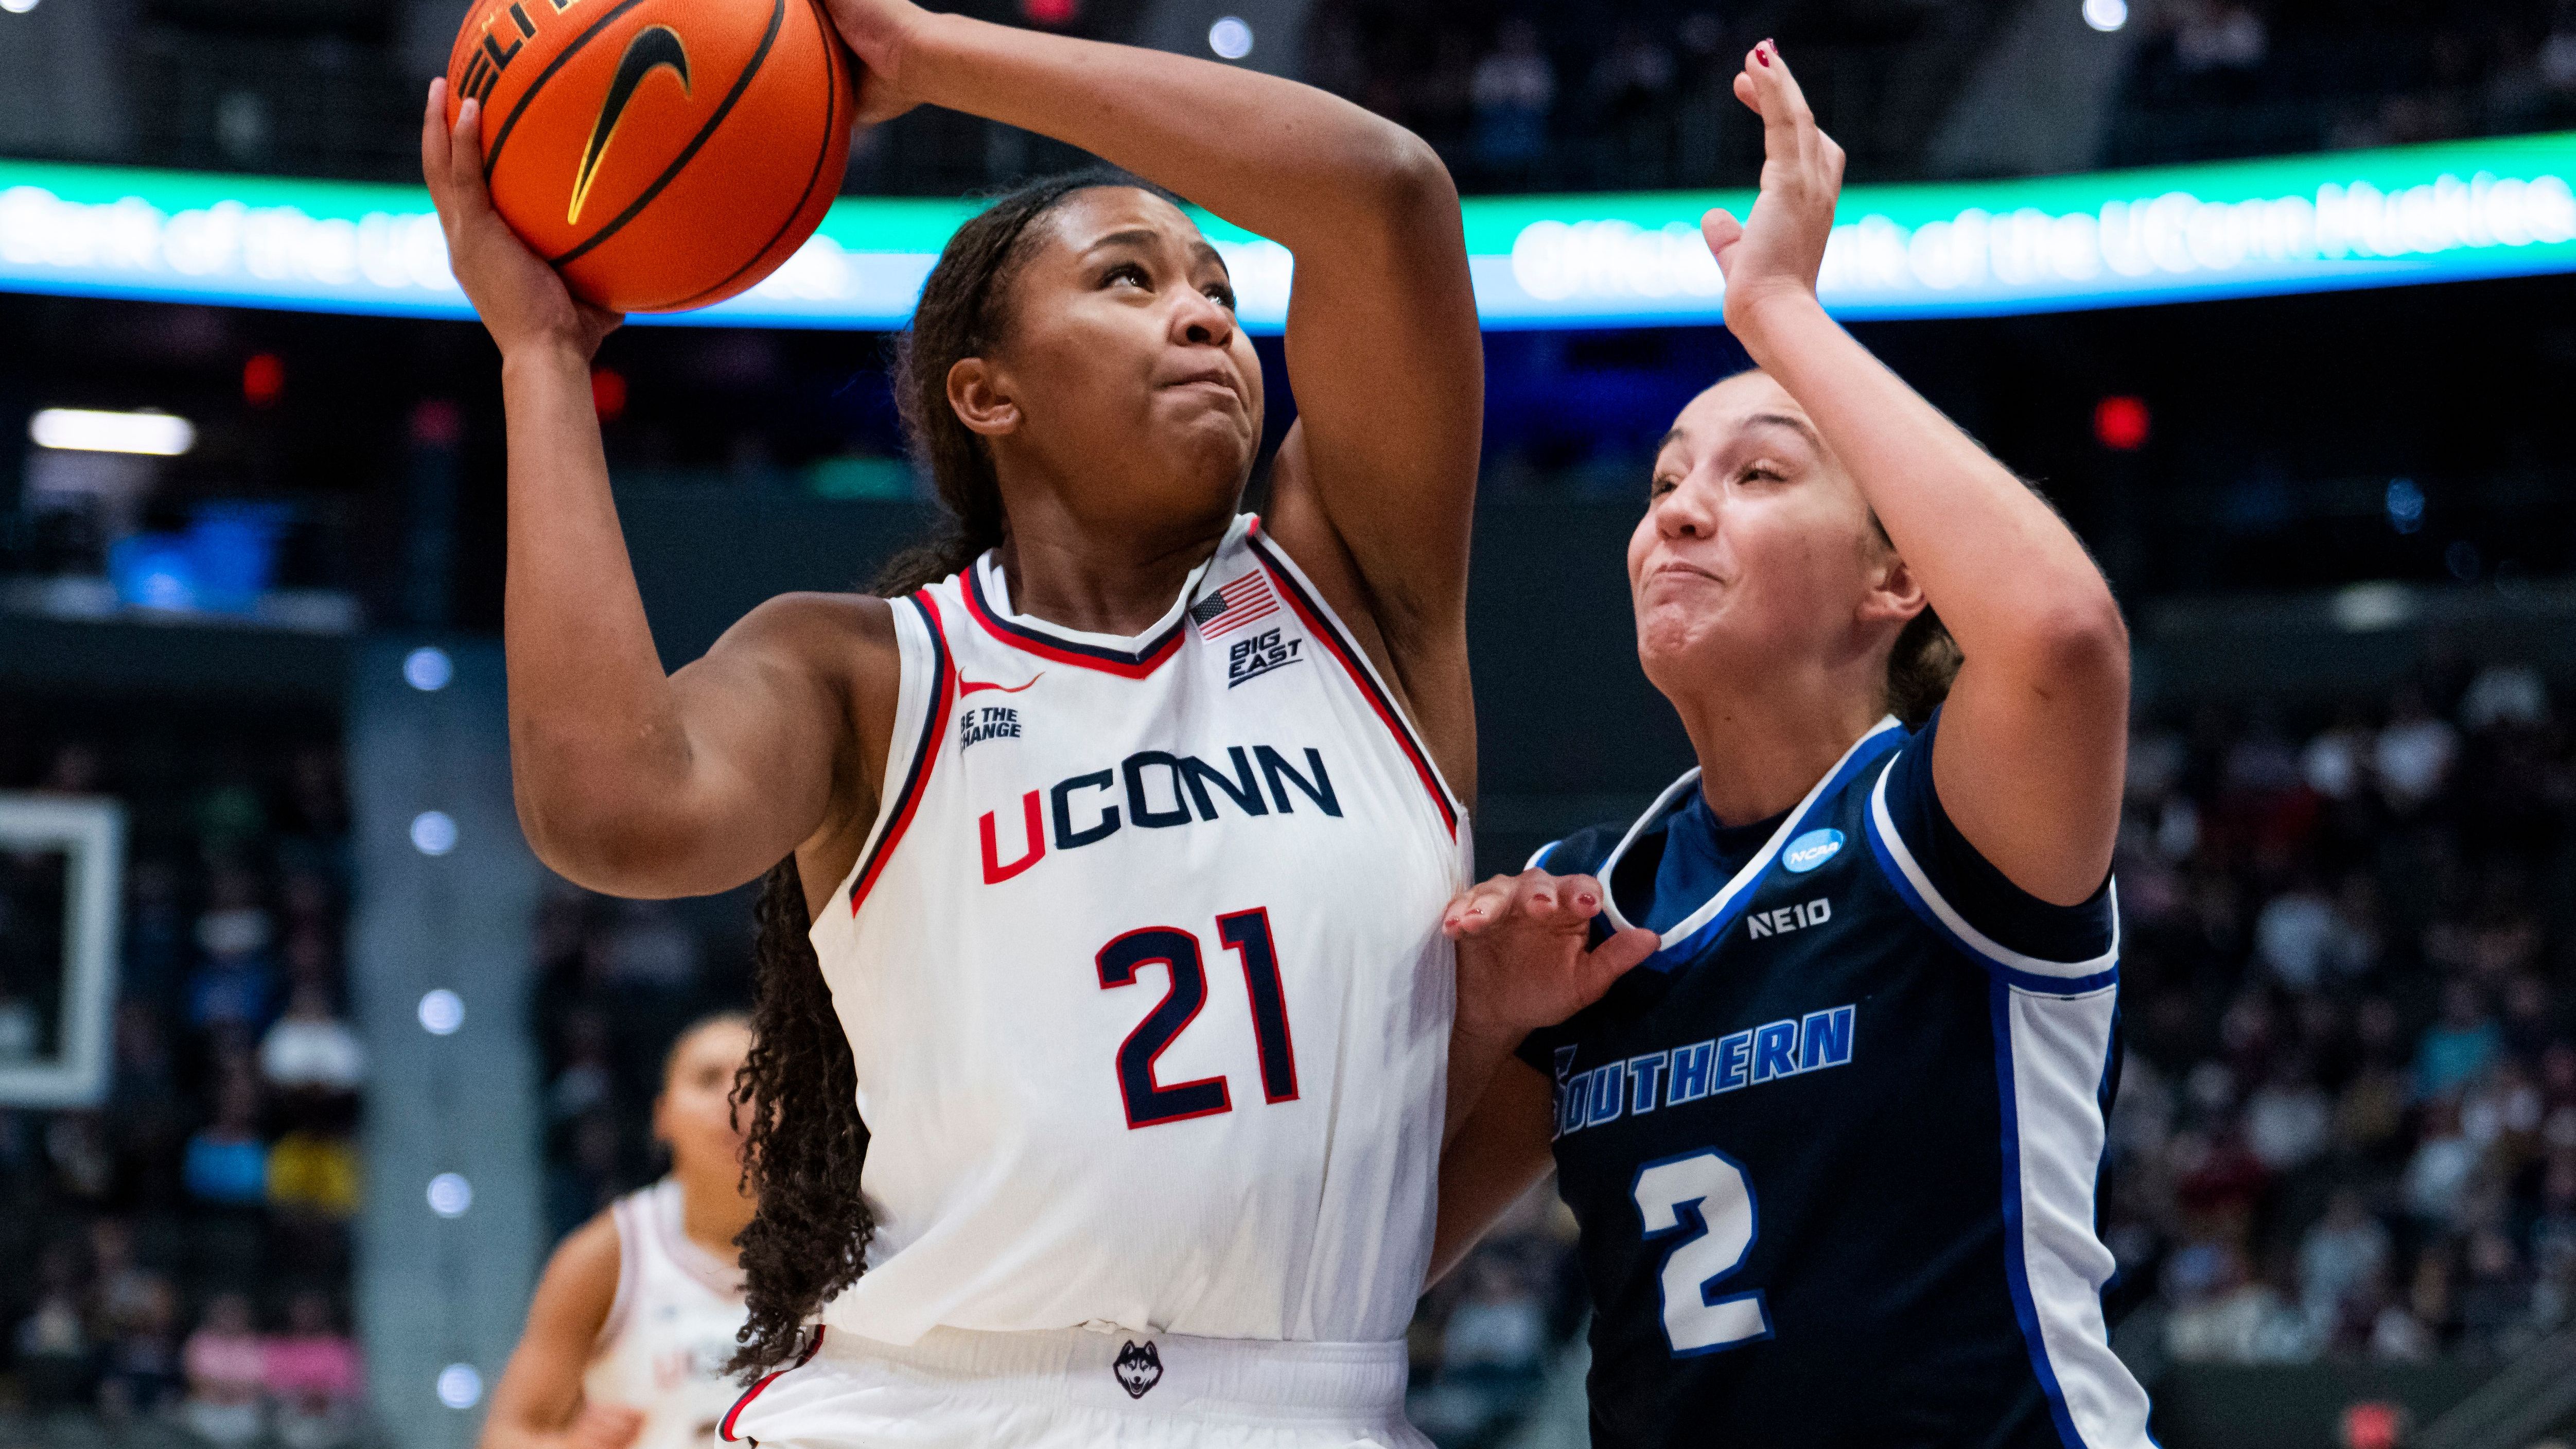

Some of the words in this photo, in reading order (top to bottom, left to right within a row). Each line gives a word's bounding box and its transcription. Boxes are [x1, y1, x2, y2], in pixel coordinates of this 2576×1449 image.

[458, 0, 582, 112] ELI
[1229, 638, 1302, 679] EAST
[1230, 626, 1281, 661] BIG
[981, 707, 1018, 723] THE
[978, 745, 1344, 885] UCONN
[1791, 841, 1839, 865] NCAA
[1747, 897, 1832, 940] NE10
[1095, 905, 1300, 1130] 21
[1627, 1145, 1776, 1359] 2
